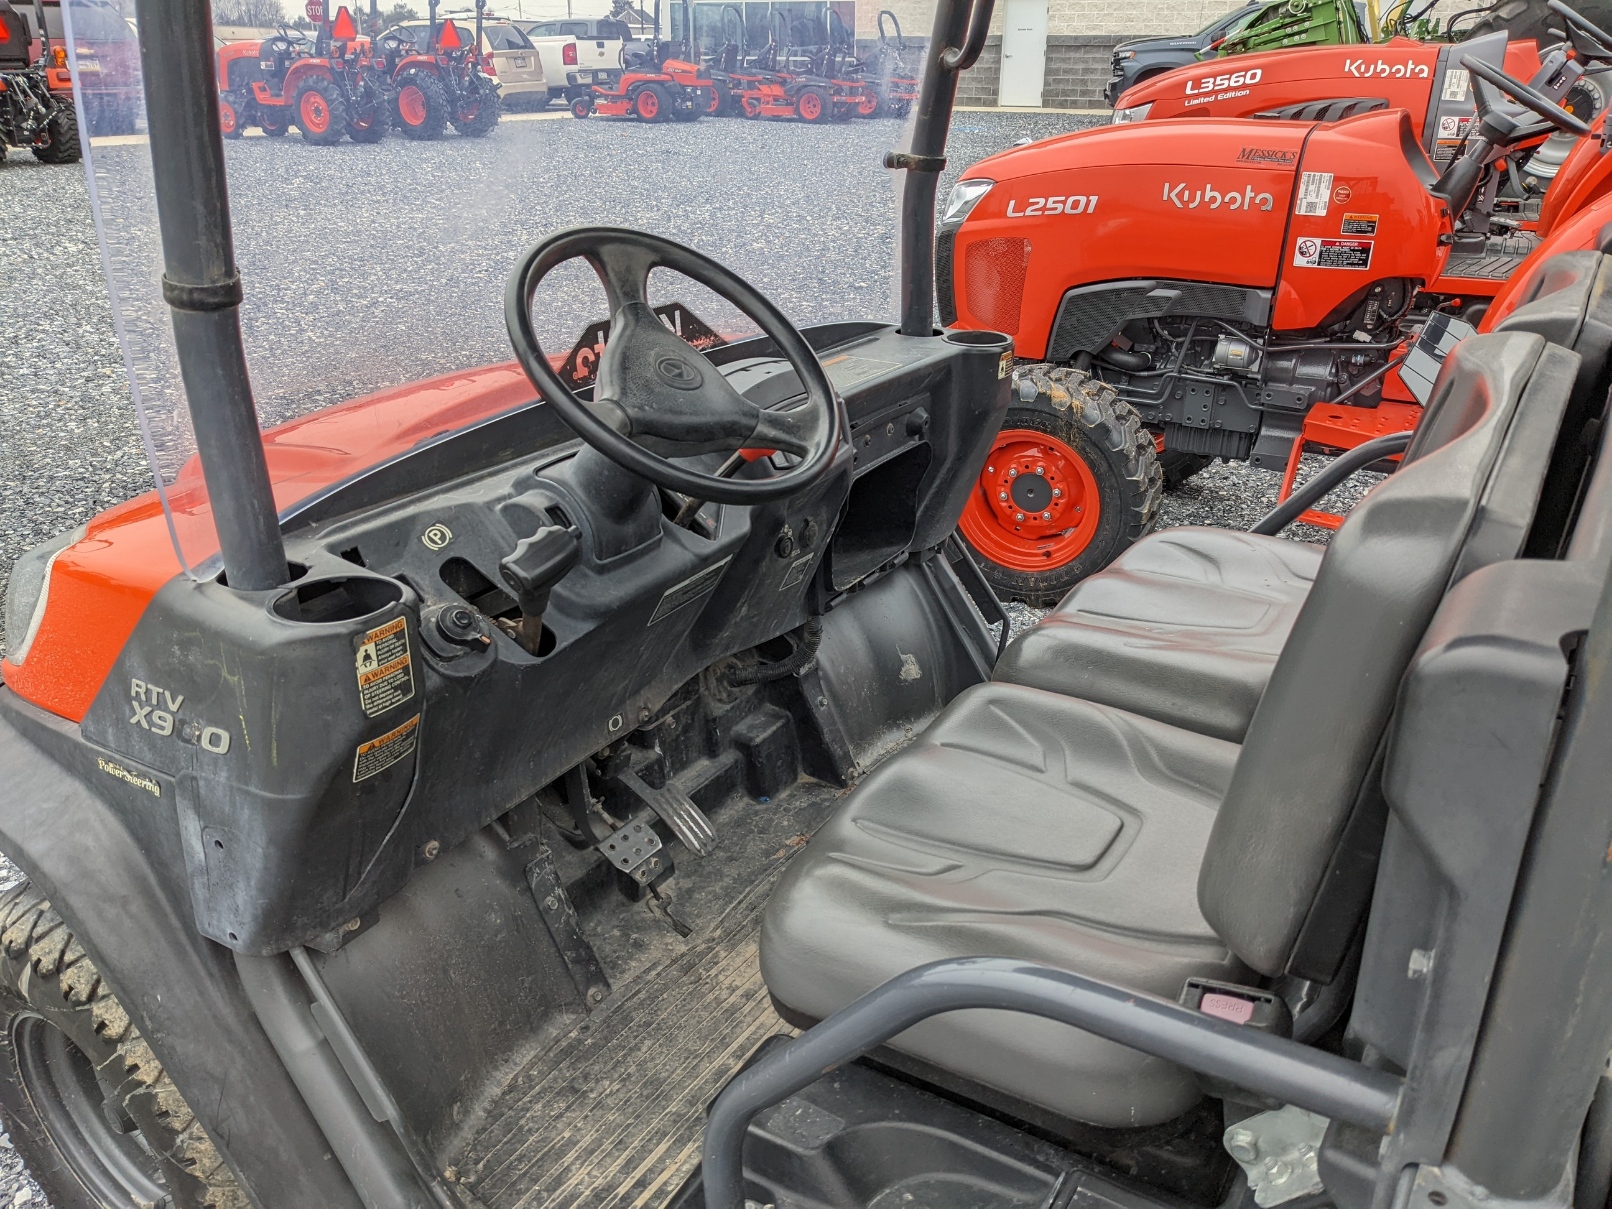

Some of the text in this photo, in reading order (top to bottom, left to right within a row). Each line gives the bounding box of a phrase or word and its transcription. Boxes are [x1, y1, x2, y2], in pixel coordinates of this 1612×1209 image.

[1344, 59, 1429, 78] Kubota
[1185, 68, 1263, 95] L3560
[1184, 89, 1250, 107] Limited Edition
[1236, 147, 1298, 160] MESSICK'S
[1006, 195, 1099, 218] L2501
[1162, 182, 1274, 212] Kubota
[367, 621, 403, 643] WARNING
[372, 657, 408, 679] WARNING
[130, 678, 185, 713] RTV
[129, 700, 232, 755] X90
[97, 757, 160, 798] Power Steering
[1210, 998, 1244, 1014] PRESS
